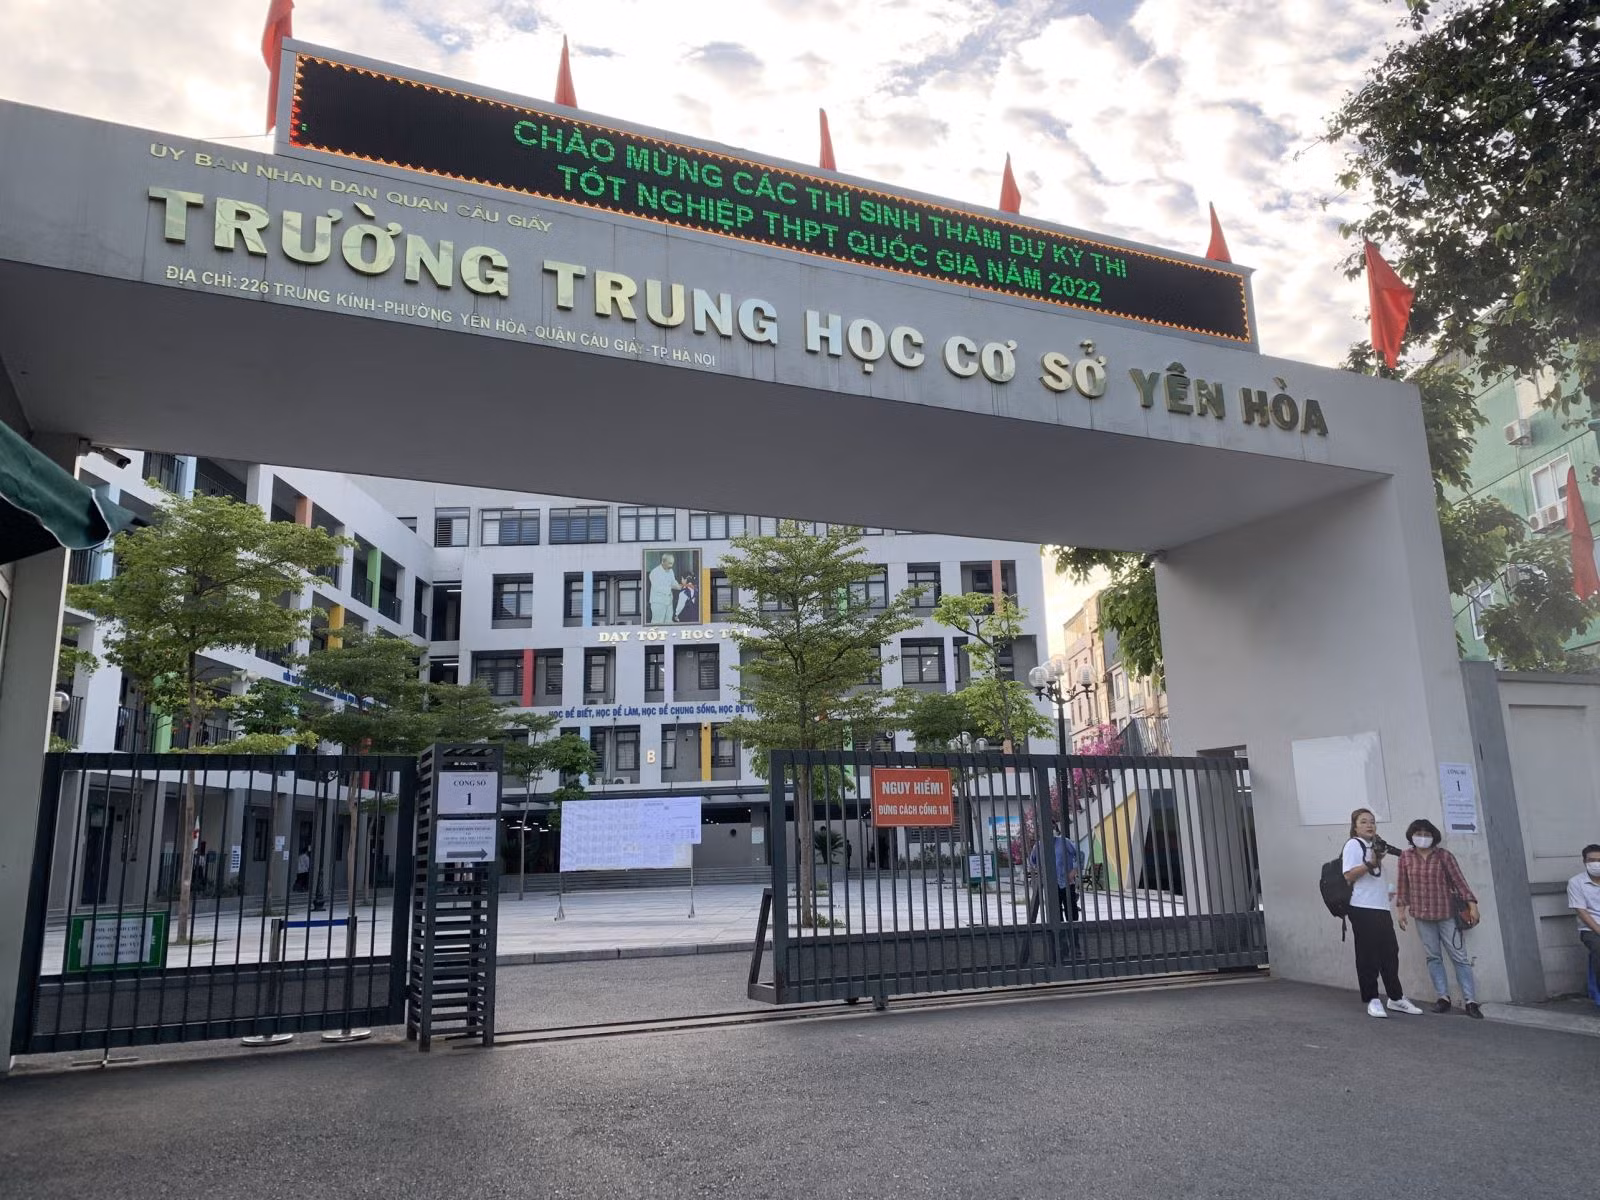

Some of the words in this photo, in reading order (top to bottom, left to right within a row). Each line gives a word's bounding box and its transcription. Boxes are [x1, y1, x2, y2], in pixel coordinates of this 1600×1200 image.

[195, 153, 247, 174] BAN
[513, 120, 615, 163] CHÀO
[626, 144, 723, 188] MỪNG
[733, 171, 798, 205] CÁC
[805, 187, 850, 218] THÍ
[859, 199, 920, 232] SINH
[928, 215, 1001, 250] THAM
[1009, 234, 1046, 264] DỰ
[1089, 252, 1127, 278] THI
[557, 164, 627, 200] TỐT
[637, 182, 754, 230] NGHIỆP
[763, 209, 839, 247] THPT
[847, 232, 928, 267] QUỐC
[936, 250, 981, 278] GIA
[987, 258, 1042, 290] NĂM
[1049, 272, 1102, 302] 2022
[165, 265, 198, 285] ĐỊA
[273, 282, 330, 303] TRUNG
[148, 186, 509, 299] TRƯỜNG
[543, 259, 778, 345] TRUNG
[804, 309, 925, 374] HỌC
[943, 335, 1018, 384] CƠ
[1039, 339, 1107, 399] SỞ
[1128, 361, 1226, 419] YÊN
[1239, 376, 1329, 437] HÒA
[598, 631, 631, 645] DẠY
[637, 626, 668, 641] TỐT
[680, 629, 714, 642] HỌC
[596, 709, 610, 718] HỌC
[641, 707, 657, 717] HỌC
[670, 706, 694, 715] CHUNG
[718, 705, 734, 714] HỌC
[646, 750, 656, 764] B
[881, 781, 910, 795] NGUY
[913, 777, 944, 795] HIỂM!
[466, 792, 472, 806] 1
[899, 803, 918, 815] CÁCH
[939, 805, 949, 815] 1M
